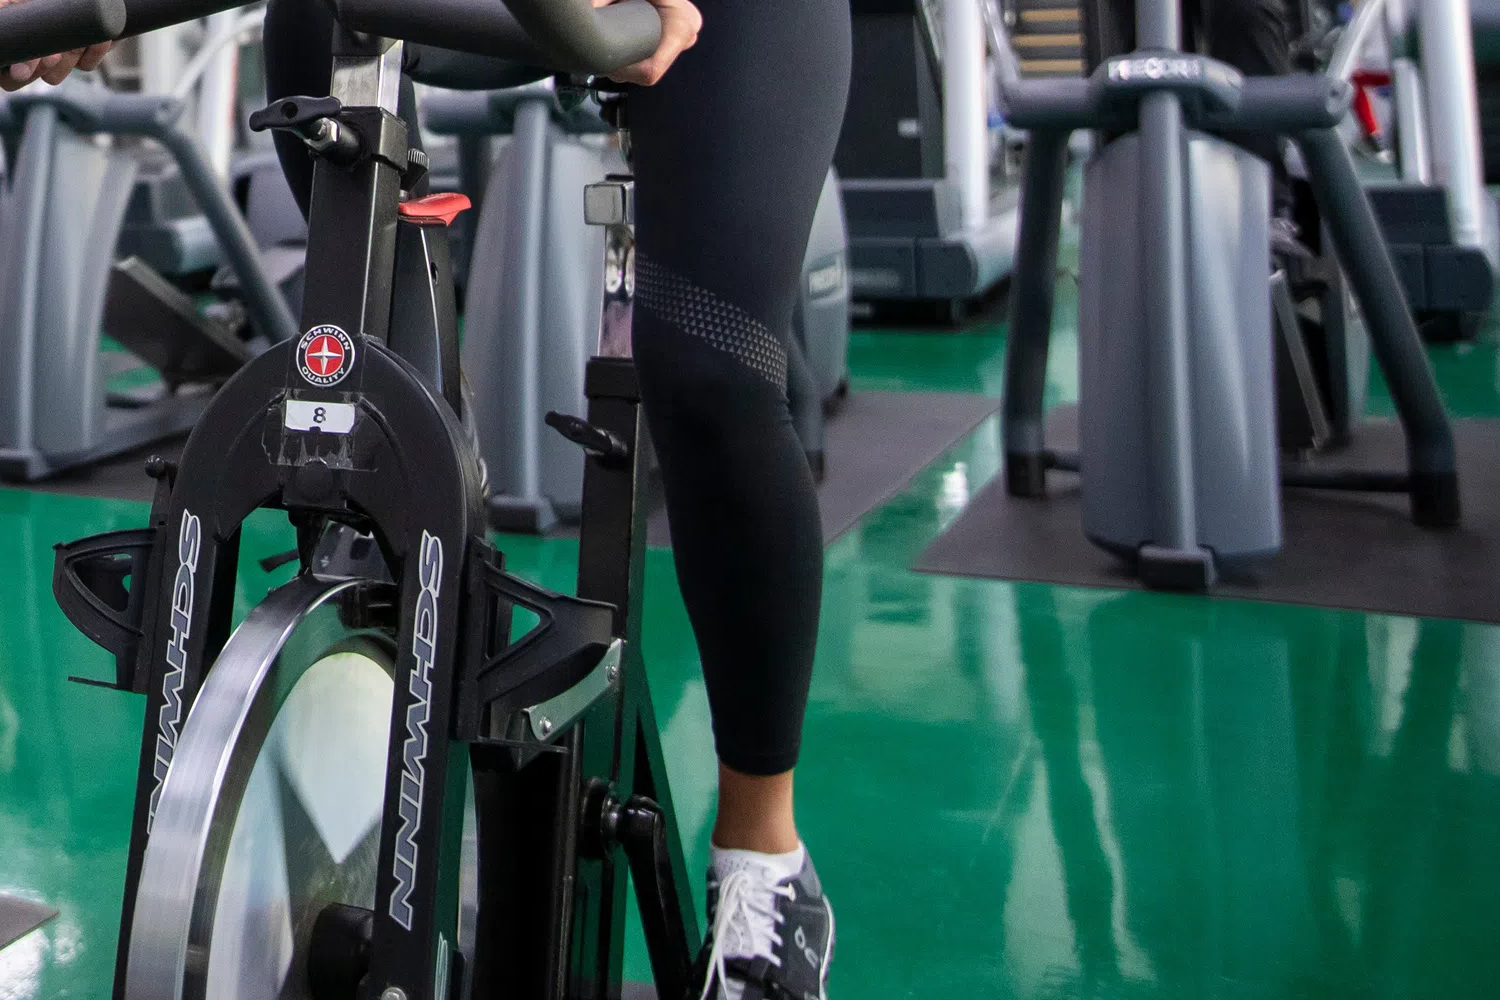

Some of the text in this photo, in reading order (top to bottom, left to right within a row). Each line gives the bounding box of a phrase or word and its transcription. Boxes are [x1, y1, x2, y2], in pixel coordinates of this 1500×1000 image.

[300, 327, 351, 351] SCHWINN
[301, 366, 345, 384] QUALITY
[312, 406, 327, 424] 8
[388, 528, 443, 932] SCHWINN
